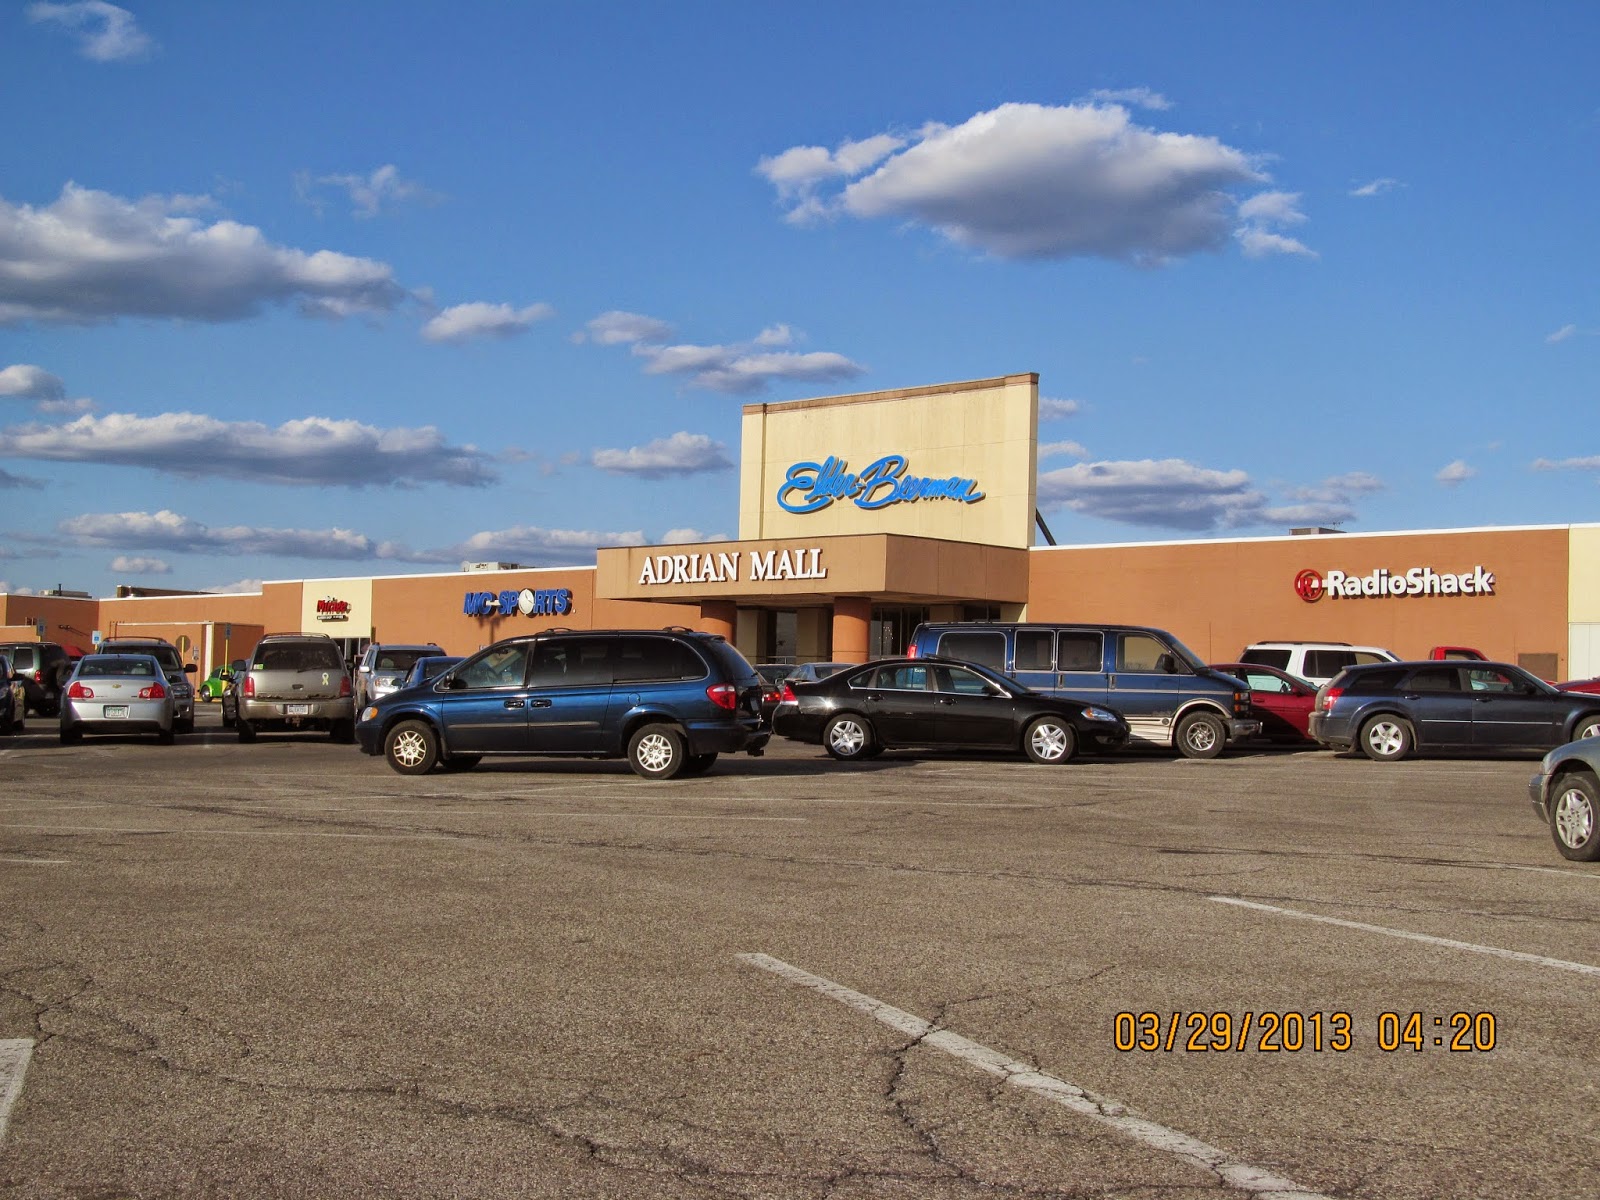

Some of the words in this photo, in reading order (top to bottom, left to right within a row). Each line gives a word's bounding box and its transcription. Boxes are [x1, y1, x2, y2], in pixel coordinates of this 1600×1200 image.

[777, 455, 983, 513] Elder-Beerman
[638, 552, 740, 585] ADRIAN
[749, 548, 827, 581] MALL
[1327, 565, 1494, 597] RadioShack
